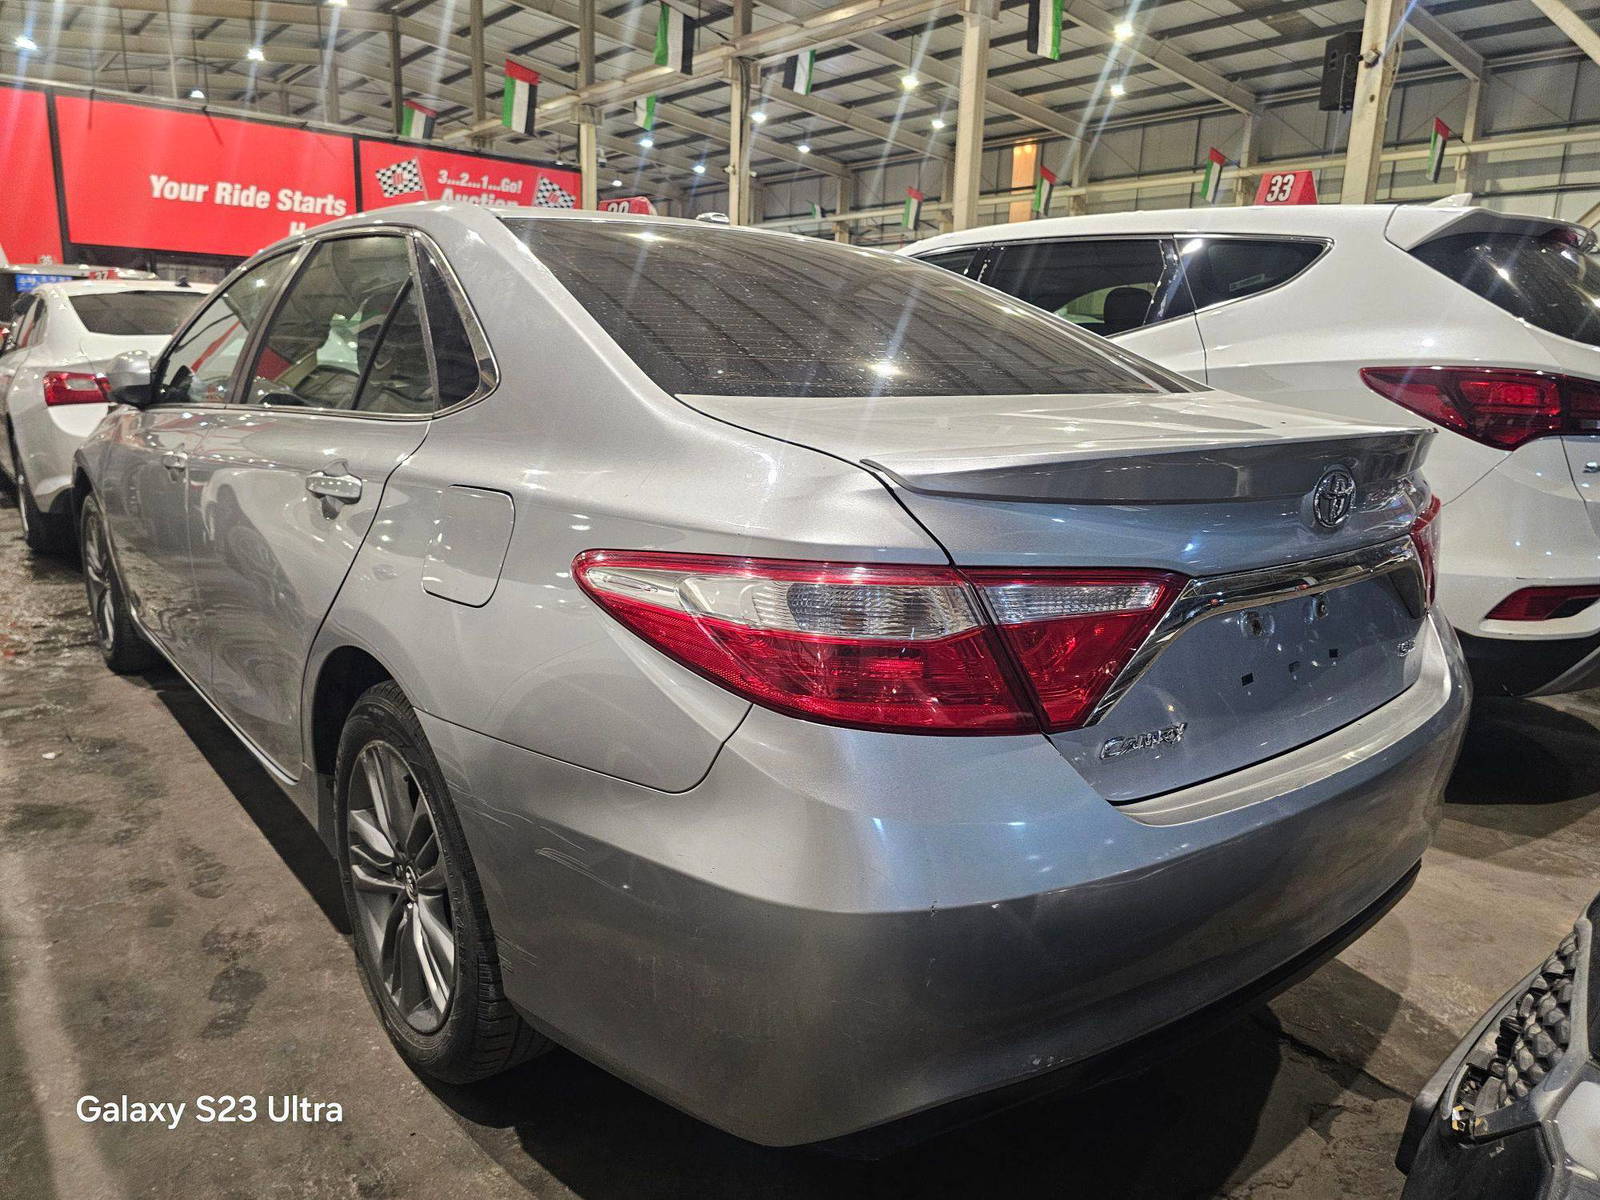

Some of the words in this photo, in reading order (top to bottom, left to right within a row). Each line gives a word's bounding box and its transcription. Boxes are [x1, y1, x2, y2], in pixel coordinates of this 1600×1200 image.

[149, 174, 209, 203] Your
[214, 181, 271, 209] Ride
[276, 189, 347, 217] Starts
[1266, 174, 1295, 202] 33
